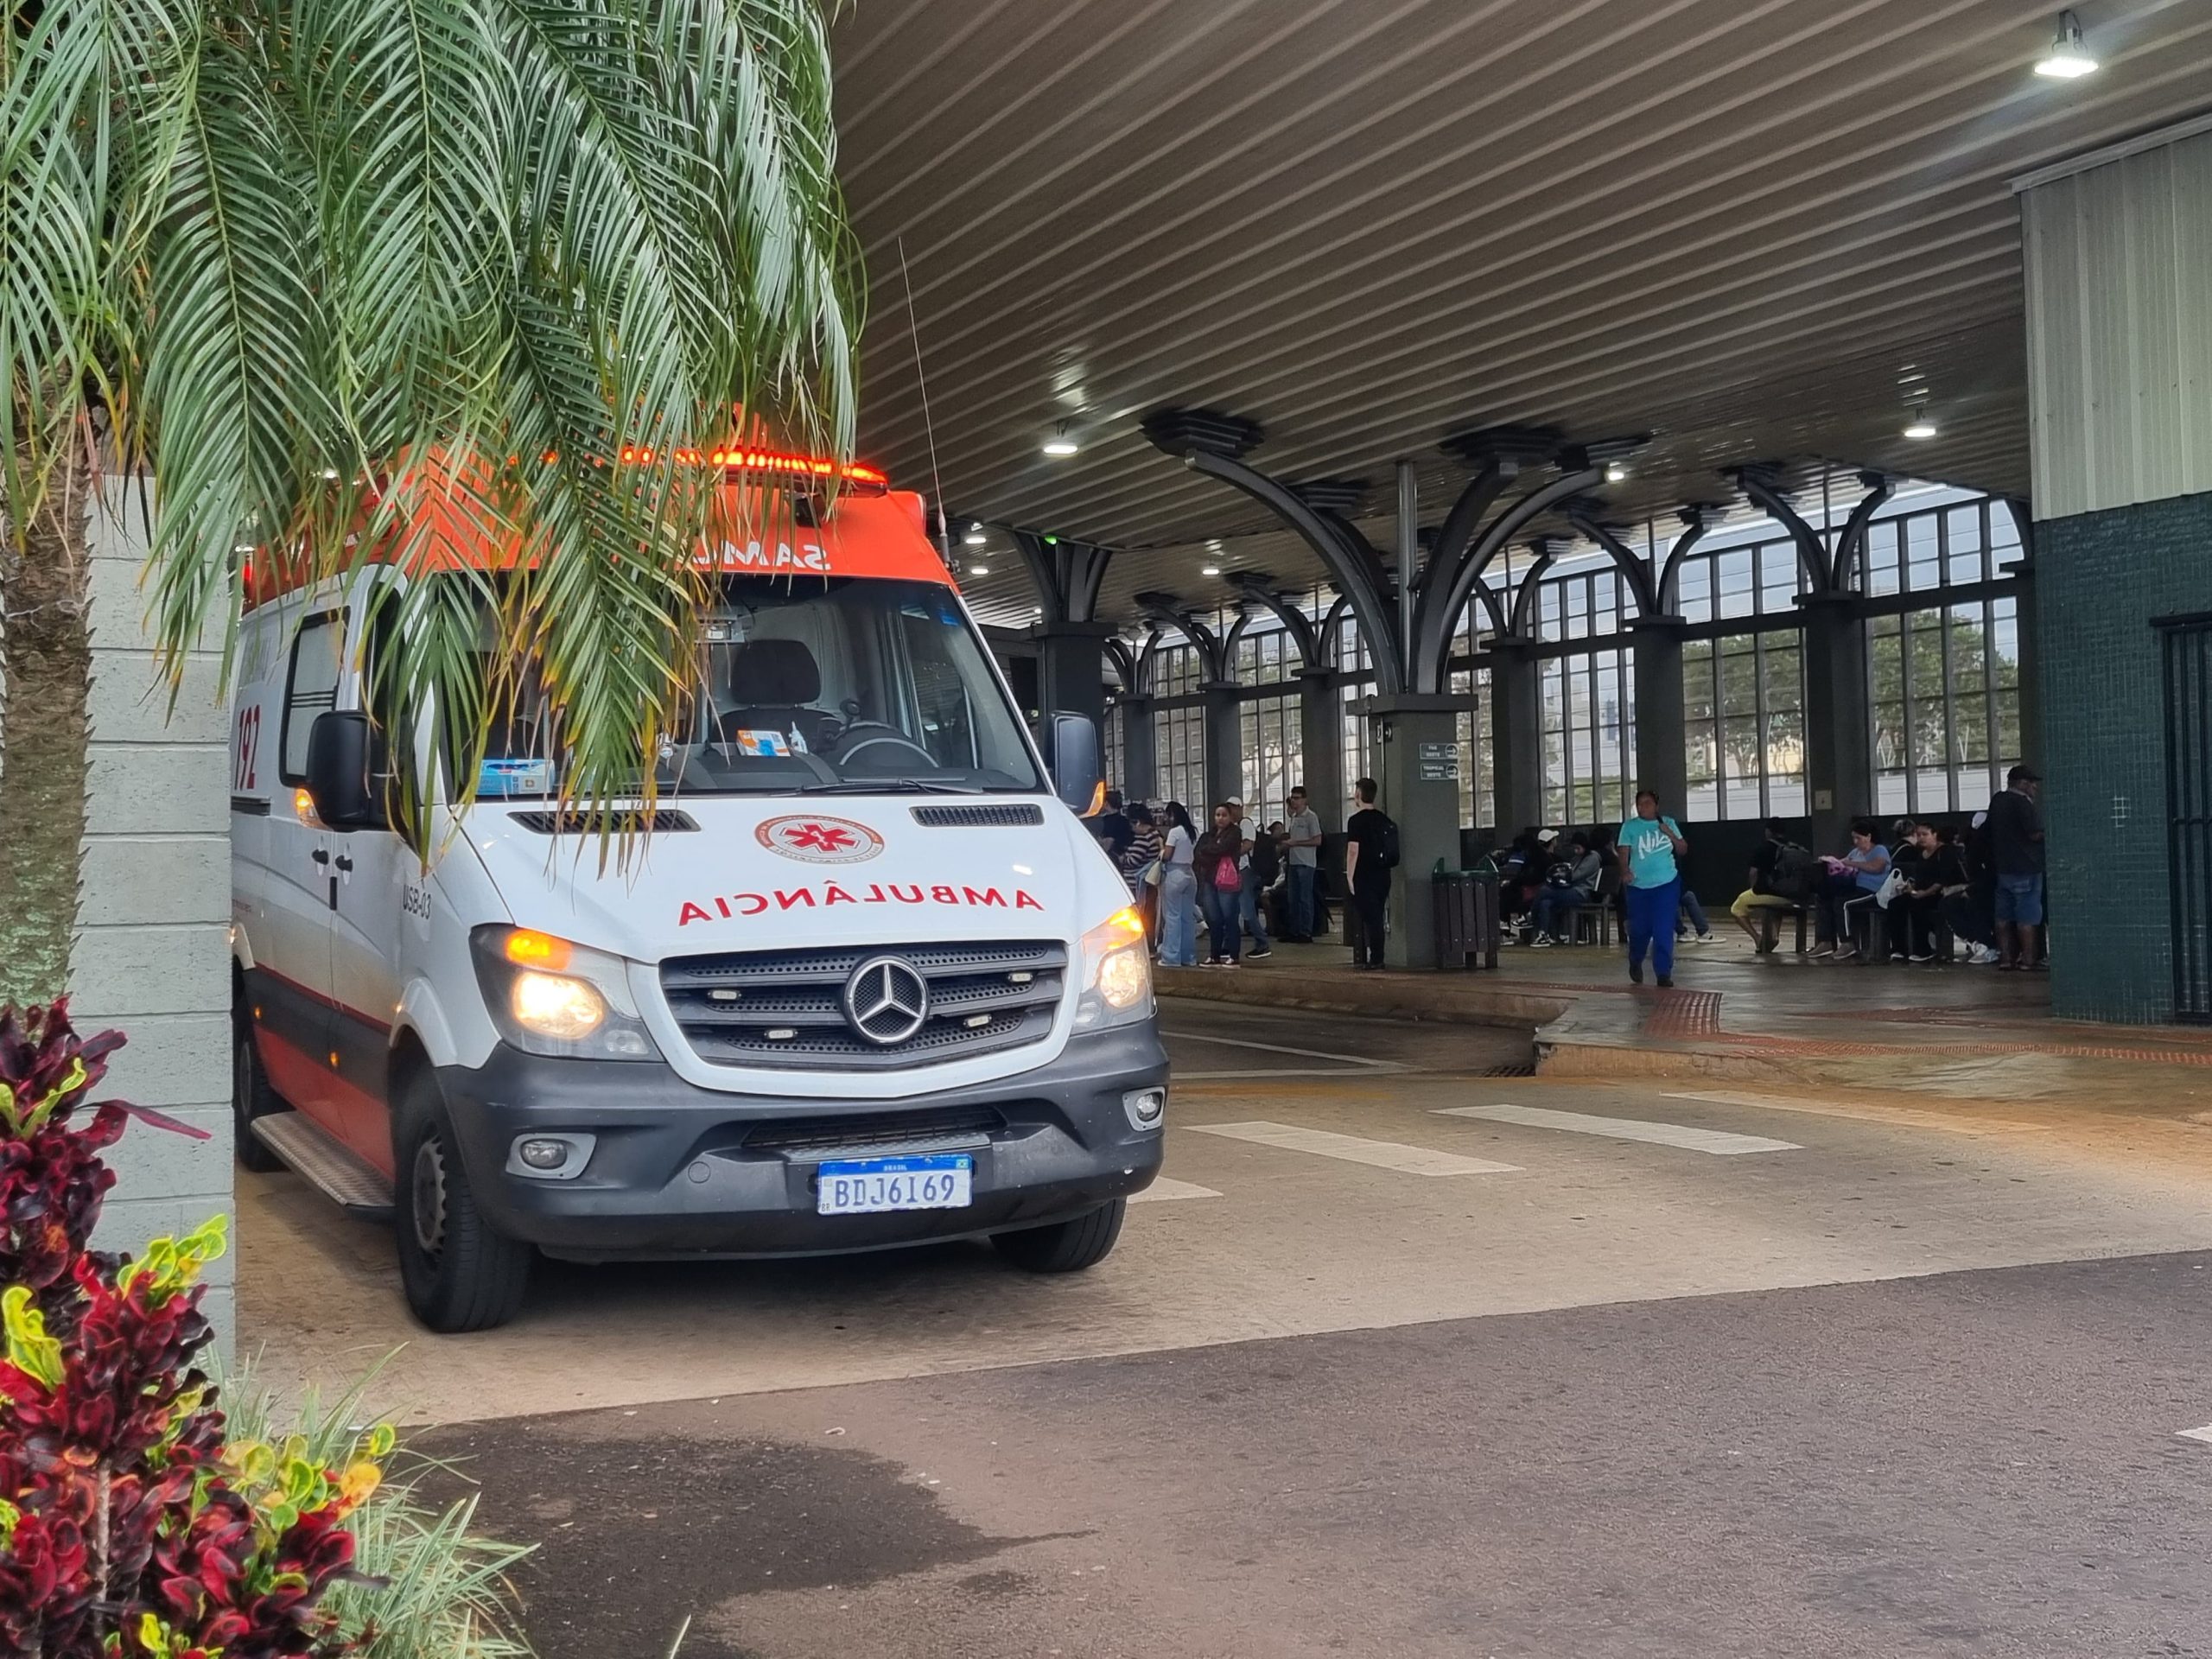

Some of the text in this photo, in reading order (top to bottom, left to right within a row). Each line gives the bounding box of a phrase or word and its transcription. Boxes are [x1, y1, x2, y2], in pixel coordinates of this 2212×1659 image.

[233, 703, 261, 791] 192
[403, 883, 432, 920] USB-03
[821, 1203, 831, 1212] BR
